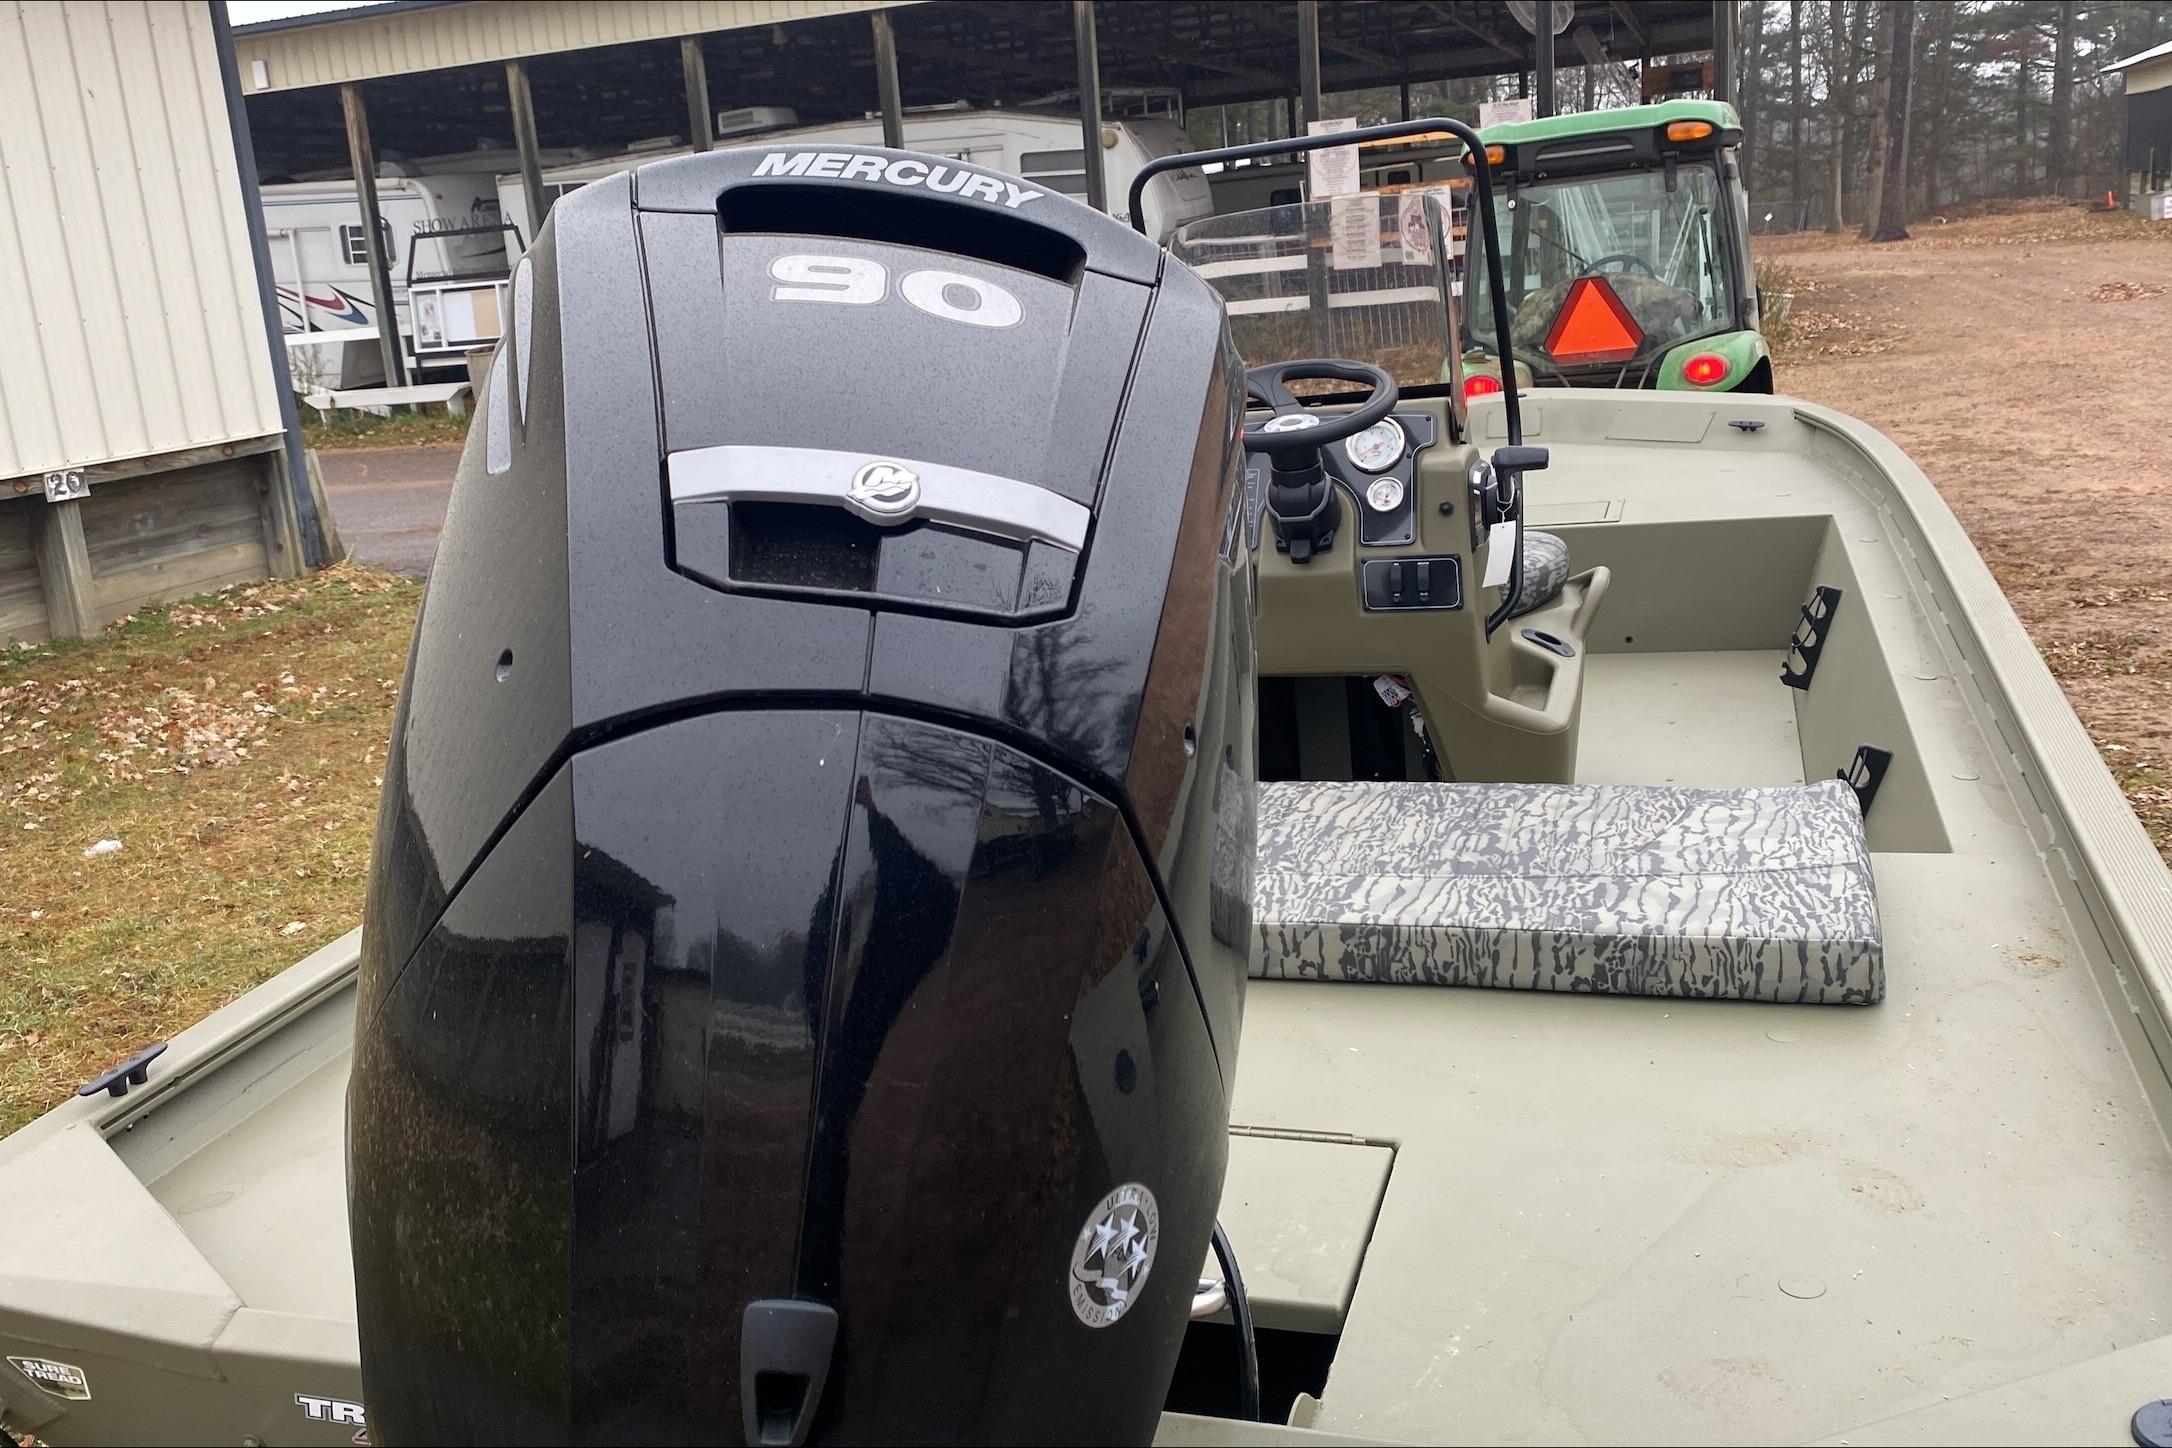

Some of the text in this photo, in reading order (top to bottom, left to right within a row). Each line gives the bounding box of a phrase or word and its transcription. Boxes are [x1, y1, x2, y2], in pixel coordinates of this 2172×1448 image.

[752, 152, 1045, 208] MERCURY
[413, 216, 457, 234] SHOW
[769, 254, 1024, 328] 90
[21, 1360, 71, 1376] SURE
[23, 1369, 83, 1385] TREAD
